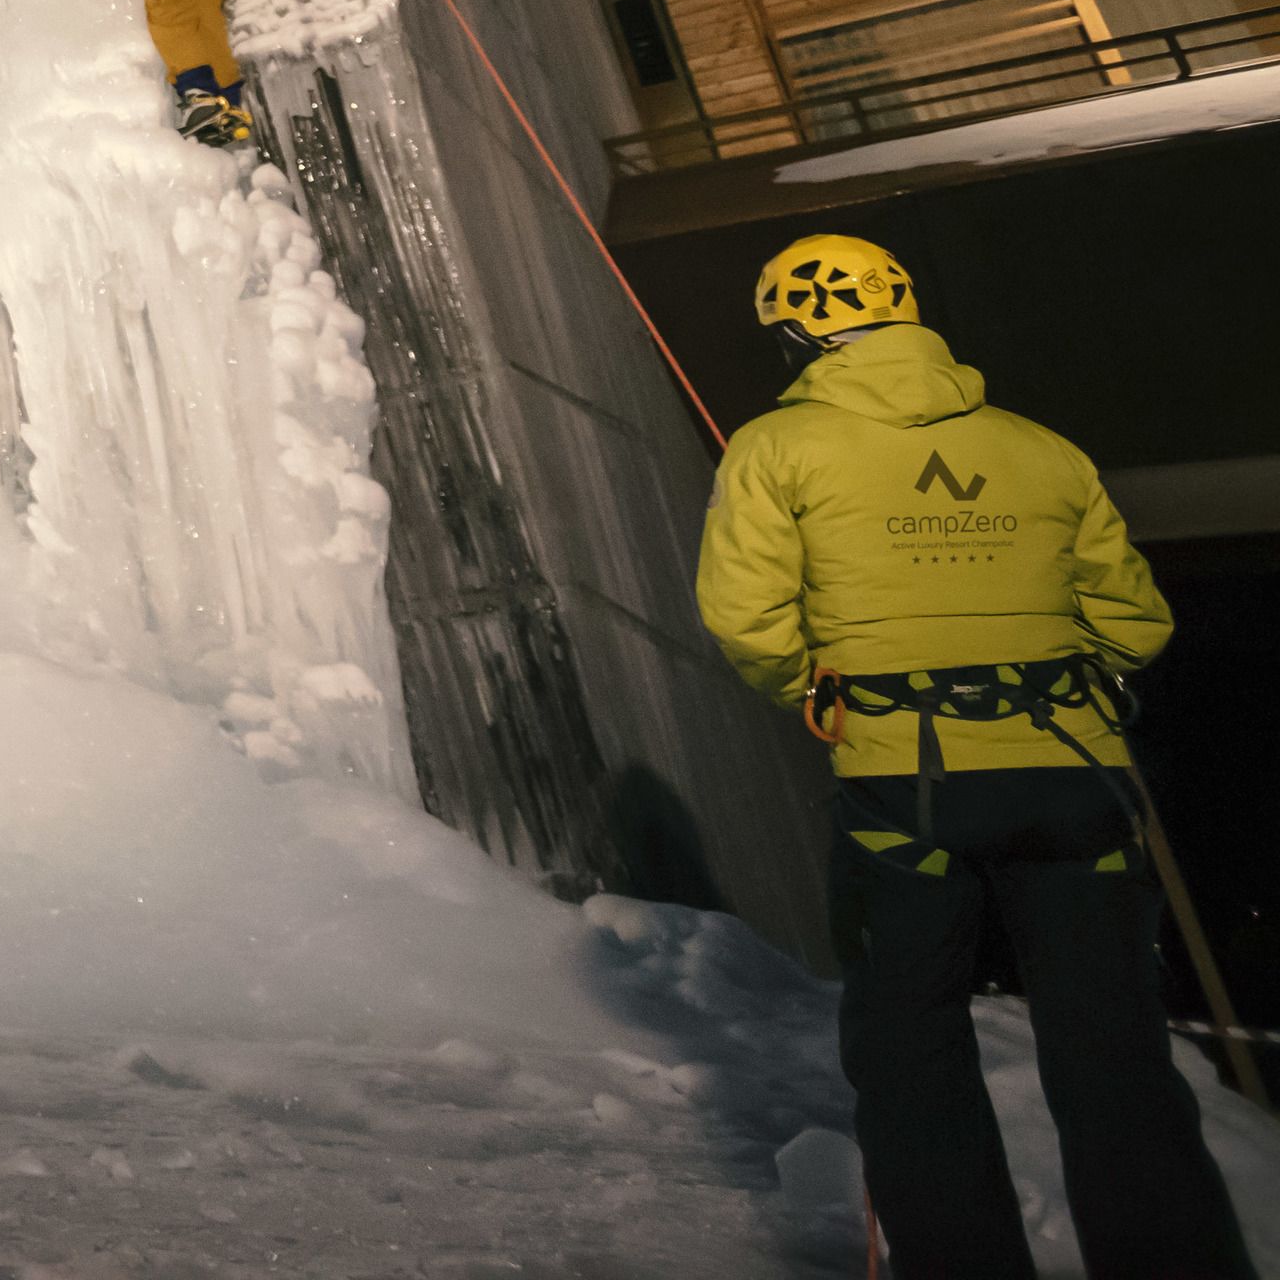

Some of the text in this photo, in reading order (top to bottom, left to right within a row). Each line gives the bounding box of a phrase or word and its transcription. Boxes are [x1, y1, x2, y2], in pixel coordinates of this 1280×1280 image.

[886, 511, 1018, 538] campZero
[891, 541, 916, 550] Active
[917, 540, 944, 550] Luxury
[945, 540, 970, 549] Resort
